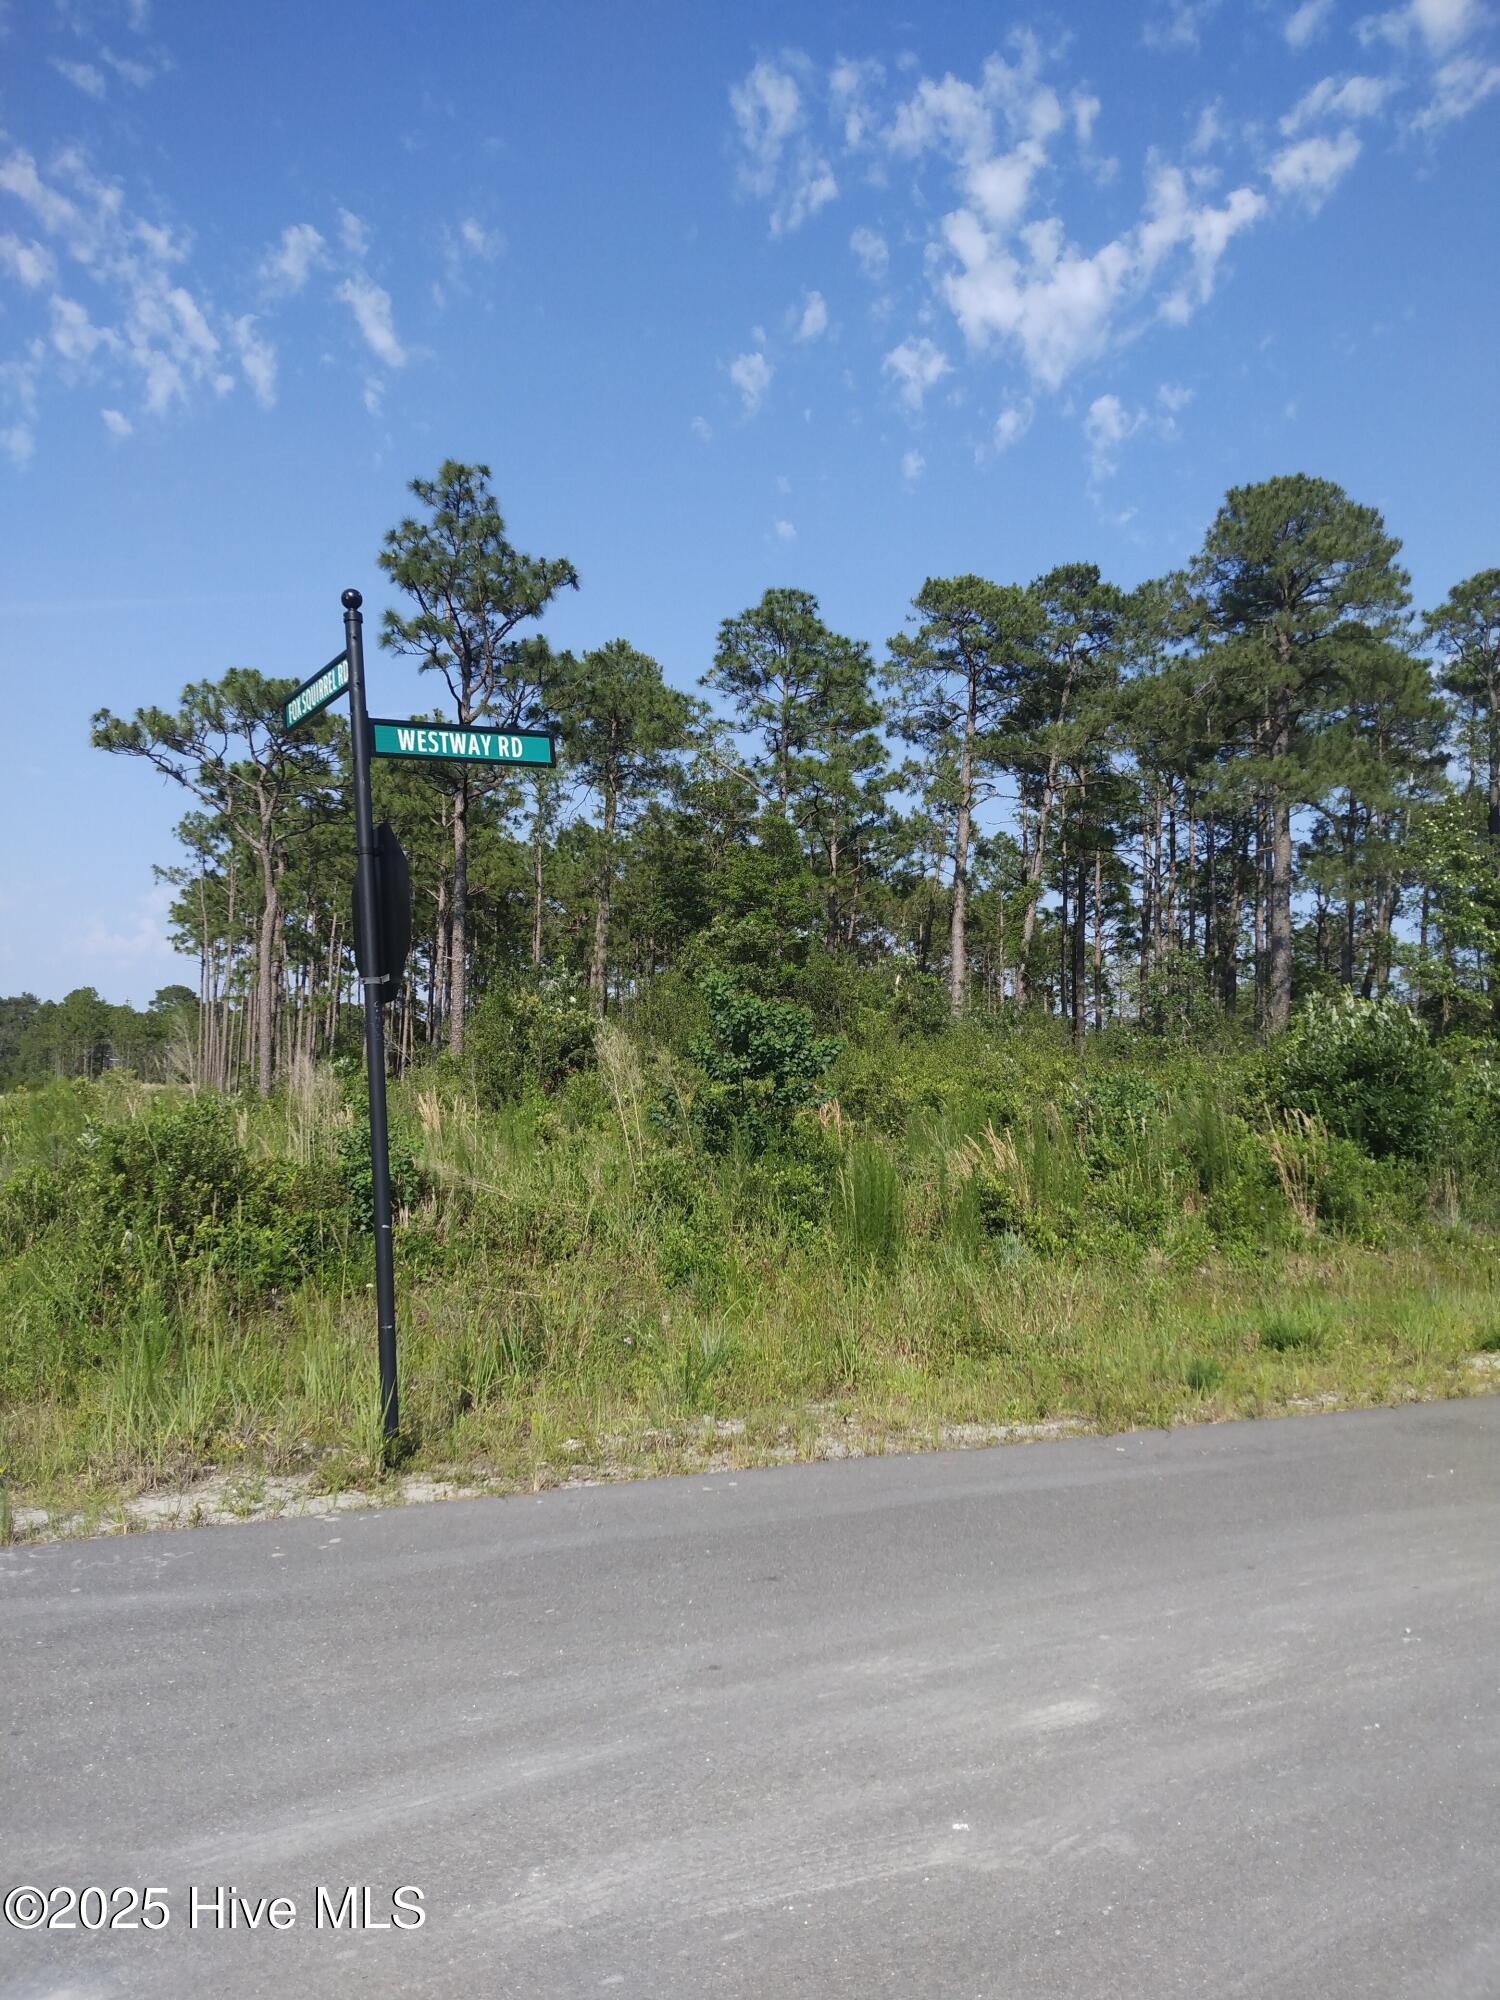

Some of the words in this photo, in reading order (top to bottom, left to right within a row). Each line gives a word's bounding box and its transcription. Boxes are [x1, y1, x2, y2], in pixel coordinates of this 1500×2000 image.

[288, 696, 302, 724] FOX
[302, 669, 337, 713] SQUIRREL
[338, 659, 349, 687] RD
[397, 729, 492, 756] WESTWAY
[498, 736, 523, 758] RD
